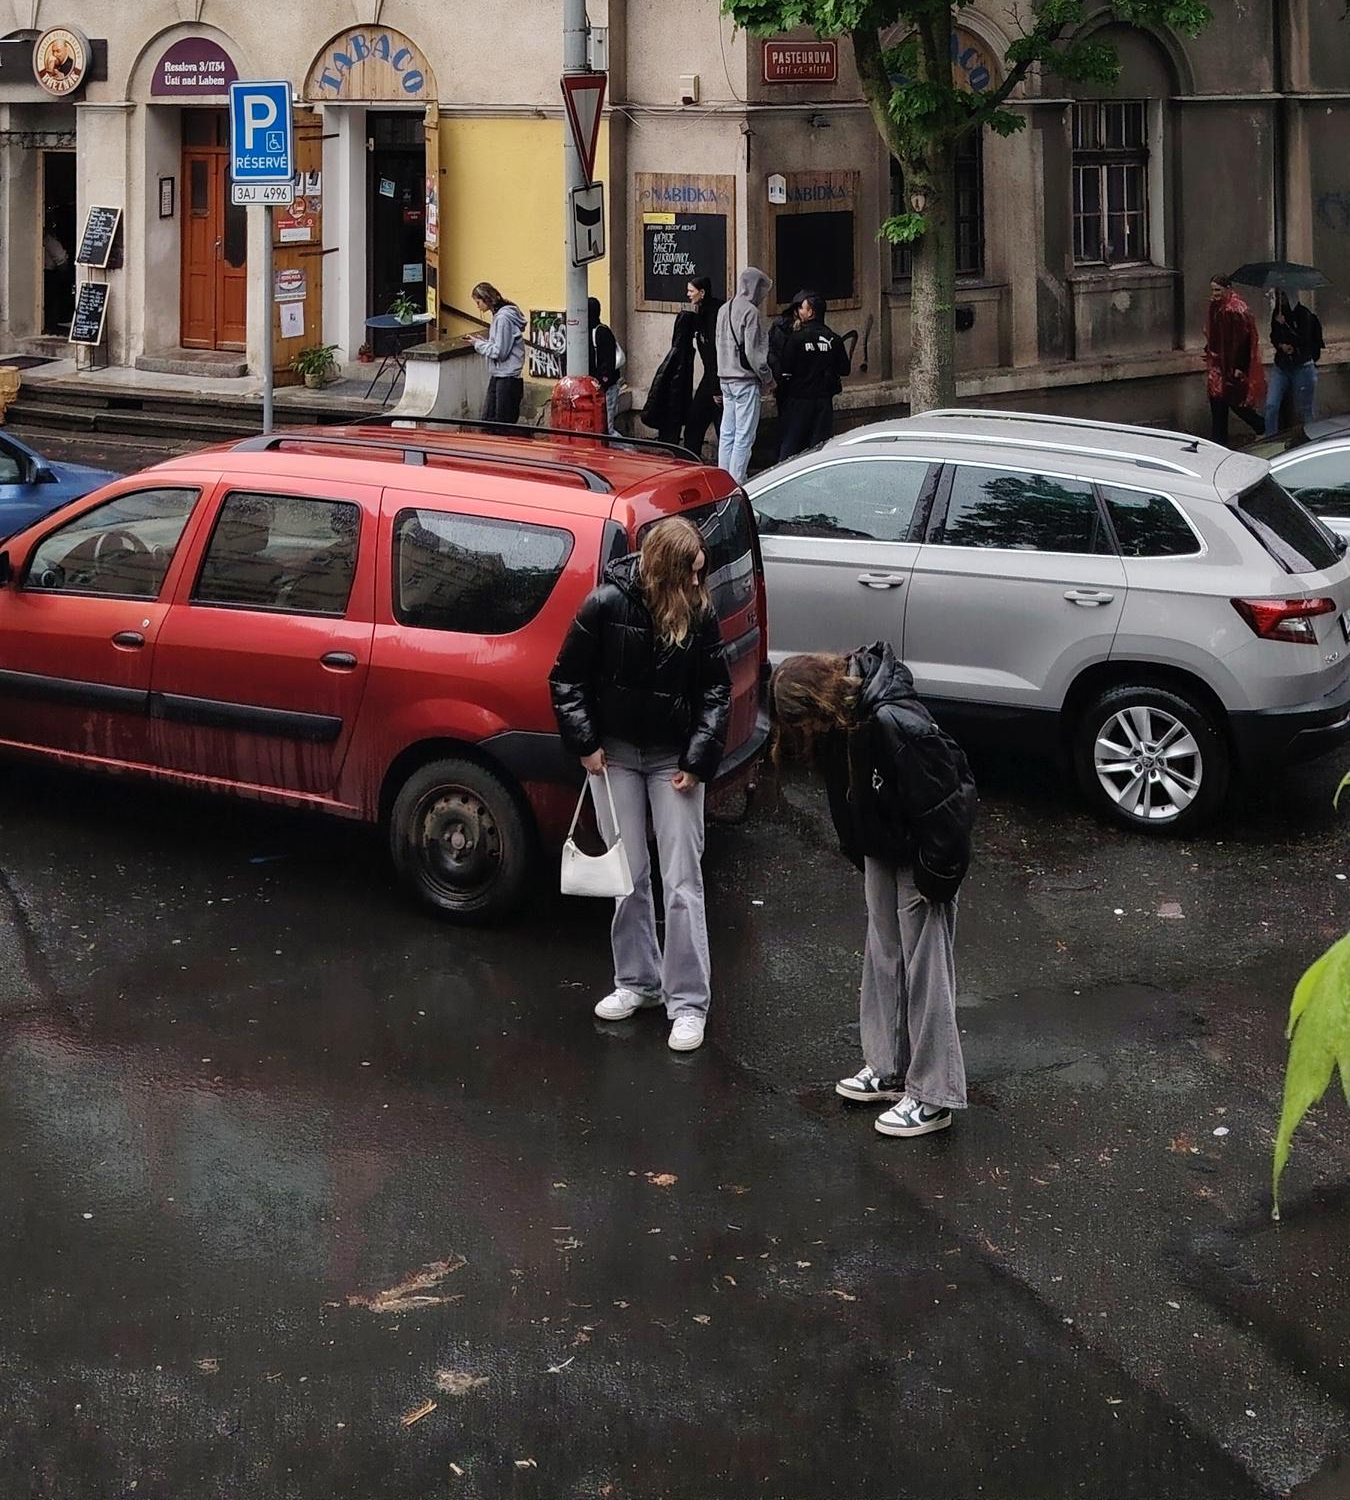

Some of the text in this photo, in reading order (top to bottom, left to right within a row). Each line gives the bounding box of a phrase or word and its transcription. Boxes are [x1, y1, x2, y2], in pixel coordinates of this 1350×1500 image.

[772, 51, 831, 64] PASTEUROVA
[164, 61, 197, 72] Resslova
[315, 34, 425, 96] TABACO
[164, 73, 225, 85] Ústí nad Labem
[243, 94, 277, 149] P
[236, 153, 288, 169] RÉSERVÉ
[237, 187, 287, 200] 3AJ 4996
